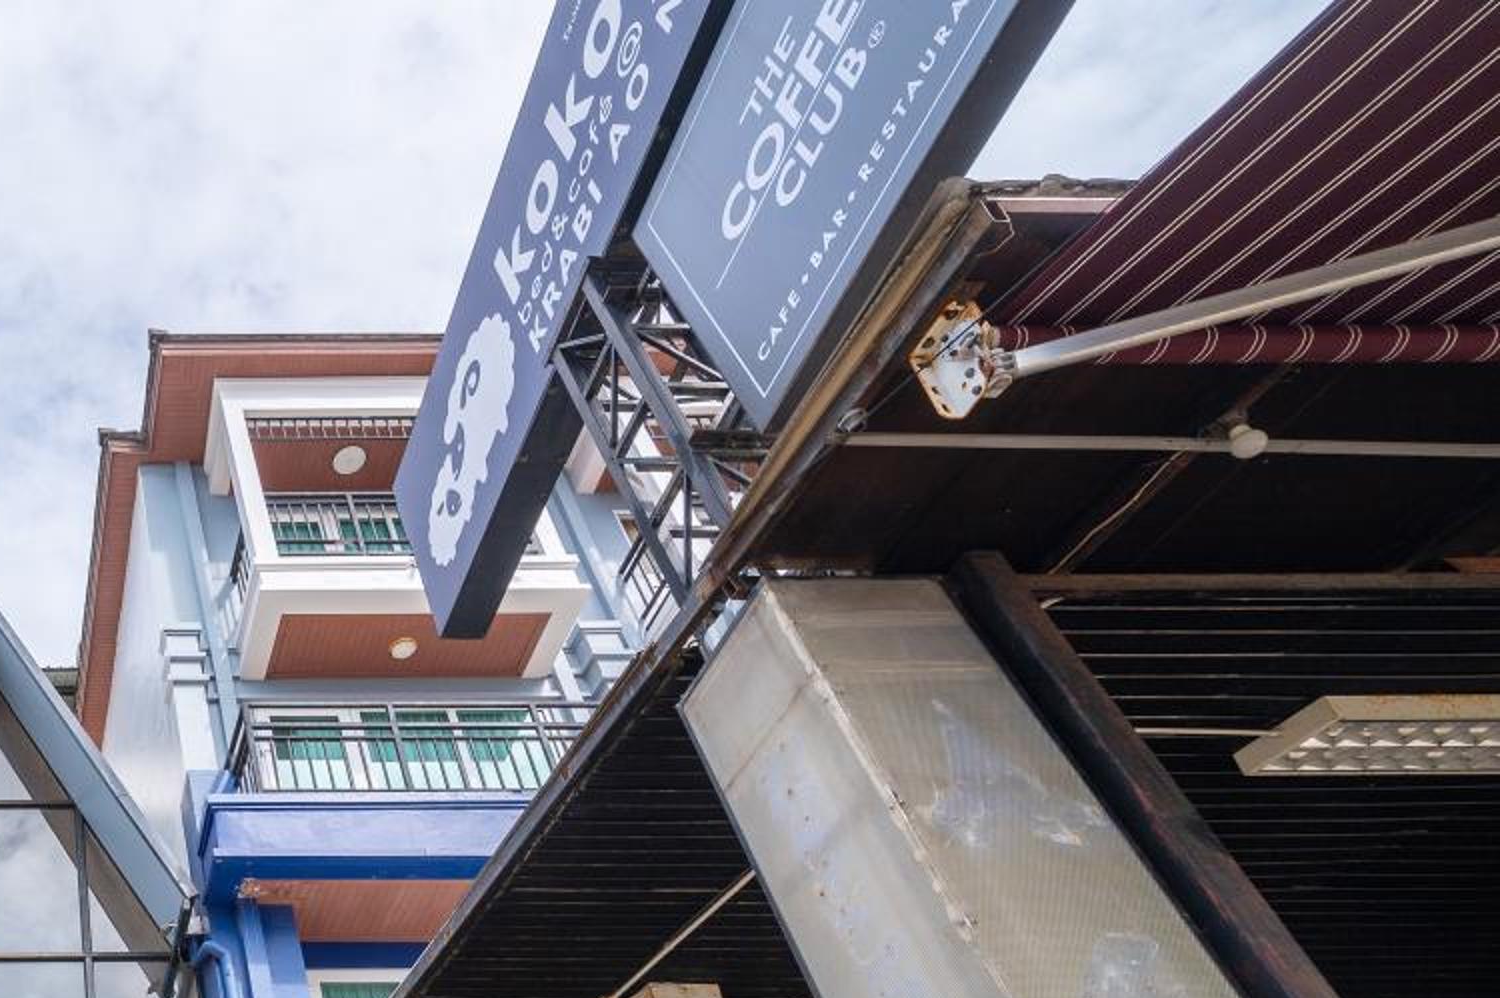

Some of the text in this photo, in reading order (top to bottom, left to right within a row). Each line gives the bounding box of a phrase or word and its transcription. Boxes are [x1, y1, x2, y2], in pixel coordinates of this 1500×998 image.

[739, 15, 797, 126] THE
[528, 178, 602, 353] KRABI
[609, 63, 649, 165] AO
[757, 289, 800, 361] CAFE
[809, 208, 848, 269] BAR
